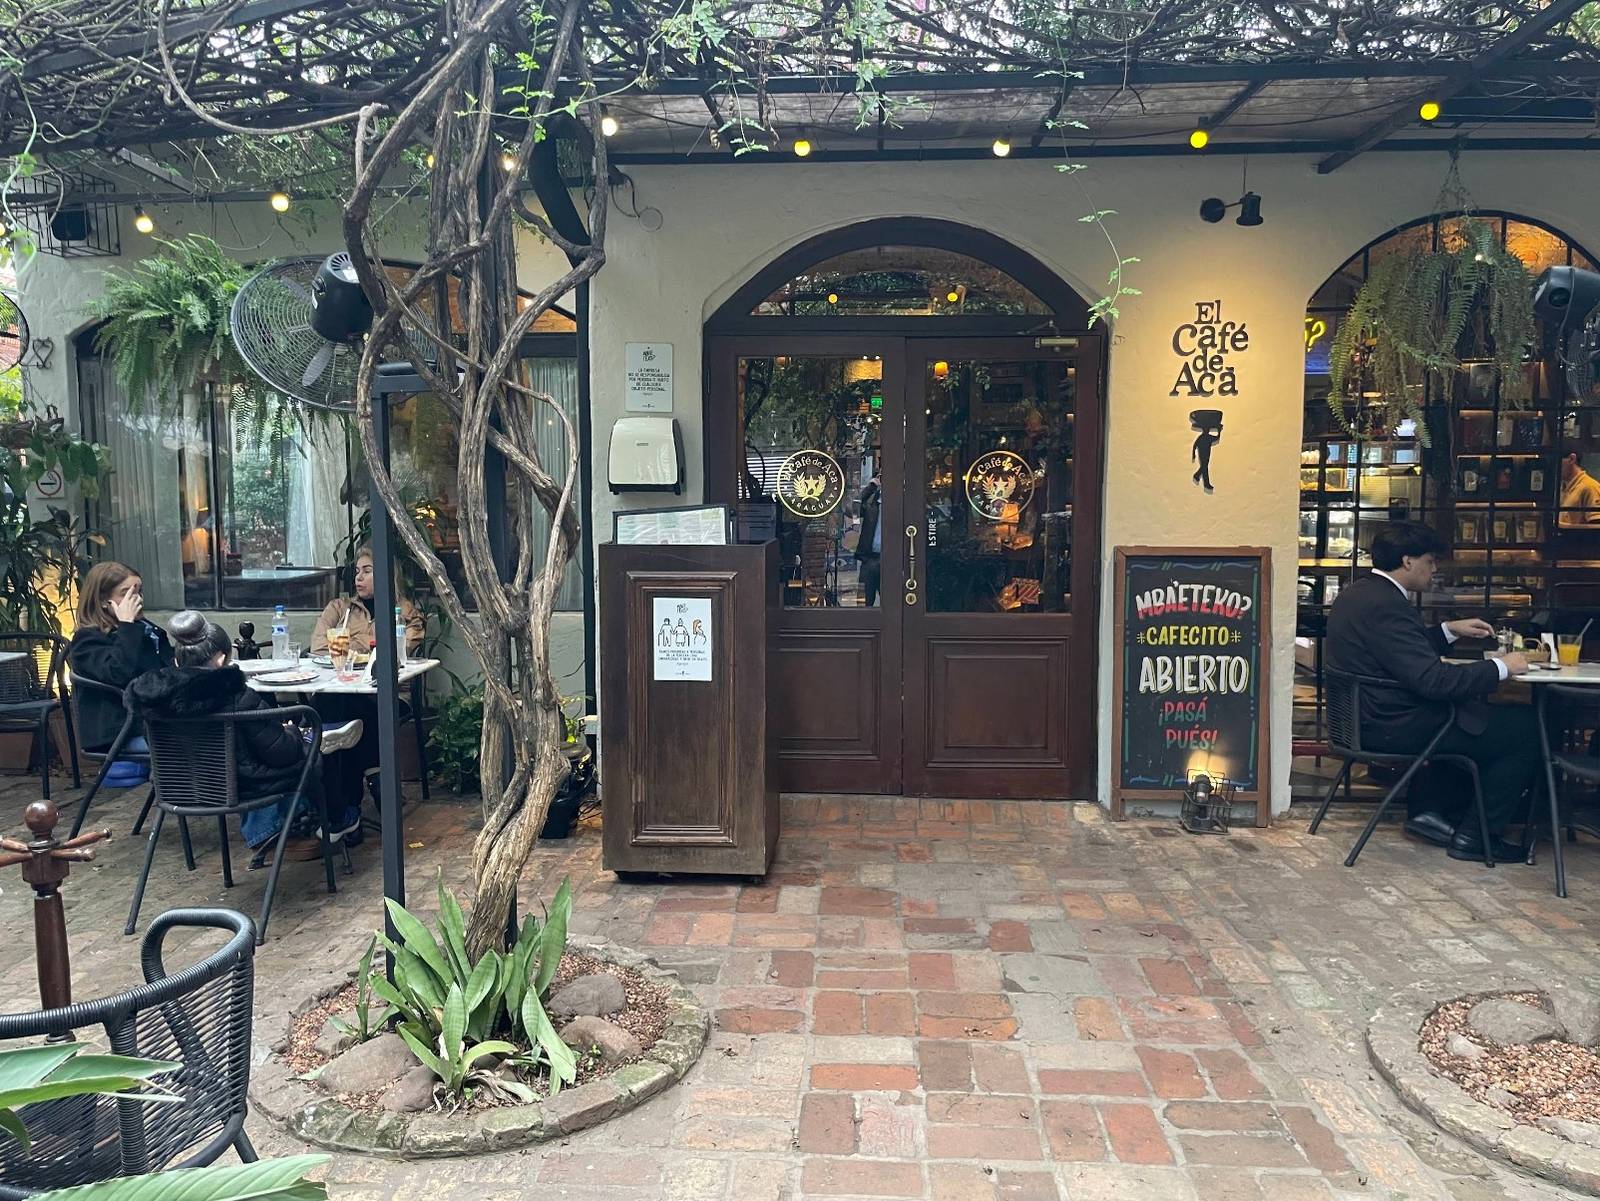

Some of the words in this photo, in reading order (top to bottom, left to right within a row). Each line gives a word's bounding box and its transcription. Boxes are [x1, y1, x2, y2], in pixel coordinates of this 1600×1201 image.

[1193, 299, 1221, 325] El
[1172, 321, 1249, 356] Café
[1192, 347, 1224, 373] de
[788, 456, 811, 474] Café
[812, 458, 823, 468] de
[977, 457, 1001, 475] Café
[786, 492, 835, 511] PARAGUAY
[928, 518, 937, 547] ESTIRE
[1146, 626, 1230, 646] CAFECITO
[1139, 655, 1250, 694] ABIERTO
[1158, 696, 1208, 726] ¡PASÁ
[1166, 724, 1218, 750] PUÉS!
